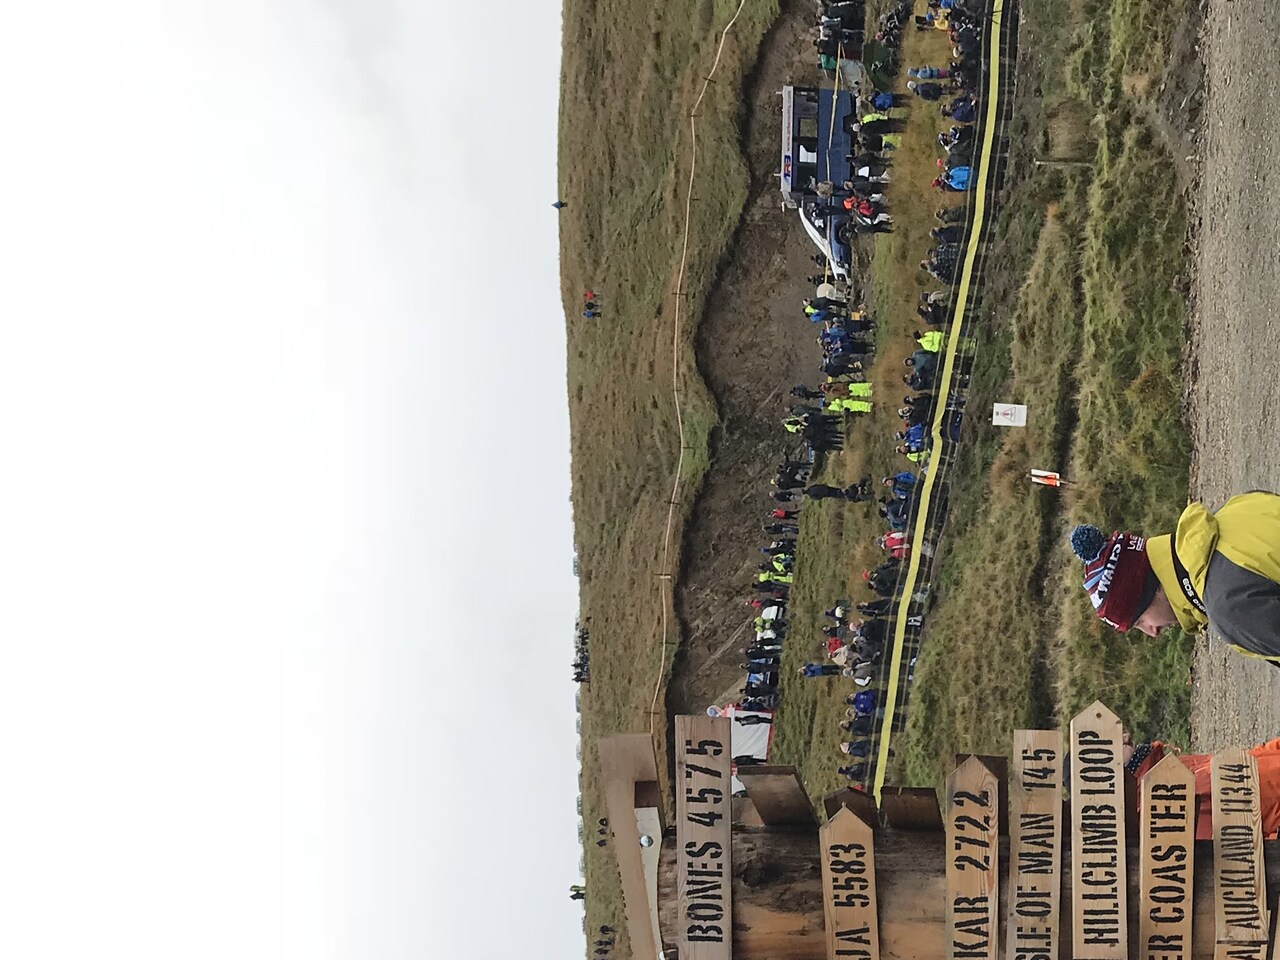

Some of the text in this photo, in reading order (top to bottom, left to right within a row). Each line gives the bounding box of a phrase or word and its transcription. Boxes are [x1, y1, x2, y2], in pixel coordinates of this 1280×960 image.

[685, 739, 724, 827] 4575
[1022, 749, 1056, 791] 145
[1078, 730, 1115, 795] LOOP
[953, 789, 990, 871] 2722
[1018, 813, 1055, 875] MAN
[1149, 783, 1187, 923] COASTER
[1219, 763, 1261, 930] AUCKLAND 11344
[685, 841, 724, 943] BONES
[829, 843, 870, 908] 5583
[1016, 885, 1052, 917] OF
[1080, 804, 1119, 945] HILLCLIMB
